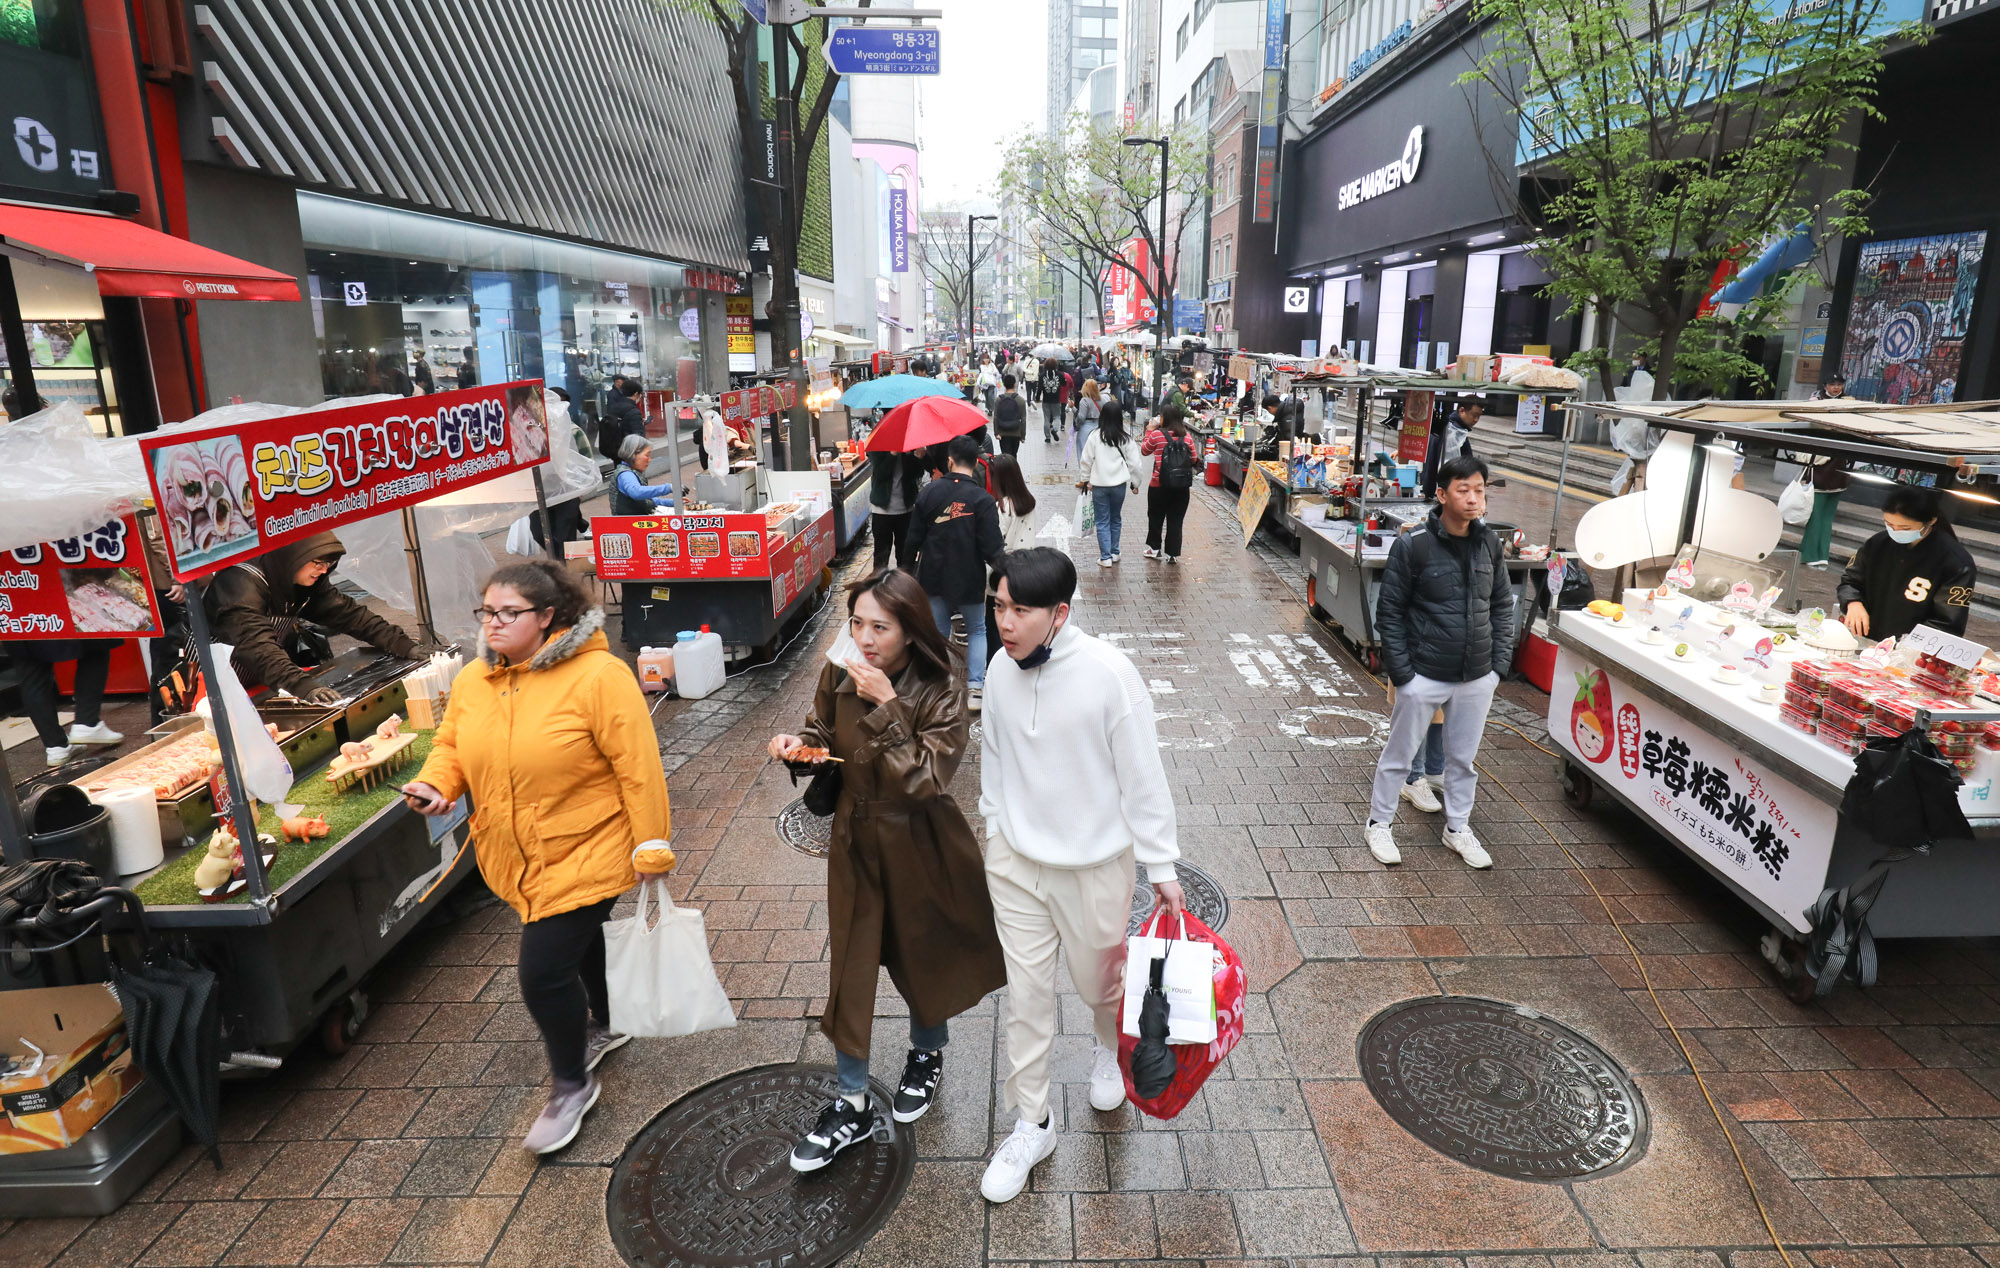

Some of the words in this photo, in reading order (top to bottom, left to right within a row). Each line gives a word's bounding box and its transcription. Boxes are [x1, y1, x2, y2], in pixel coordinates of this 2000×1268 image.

[892, 32, 937, 48] 명동3길
[854, 50, 913, 62] Myeongdong
[915, 51, 937, 61] 3-gil
[766, 143, 775, 178] balance
[1257, 160, 1274, 219] 산부인과
[1338, 177, 1362, 211] SHOE
[1360, 159, 1401, 203] MARKER
[894, 193, 904, 230] HOLIKA
[894, 231, 905, 268] HOLIKA
[1820, 310, 1829, 318] 26
[265, 514, 294, 537] Cheese
[294, 503, 320, 528] kimchi
[320, 500, 333, 519] roll
[333, 495, 351, 518] pork
[350, 489, 369, 512] belly
[683, 517, 725, 531] 닭꼬치
[8, 570, 38, 589] belly
[1904, 576, 1932, 602] S
[1619, 709, 1639, 776] 純手工
[1642, 729, 1790, 882] 草莓糯米糕
[1171, 987, 1193, 995] YOUNG
[17, 1097, 48, 1107] CALIFORNIA
[21, 1093, 41, 1101] CITRUS
[23, 1103, 46, 1112] PREMIUM
